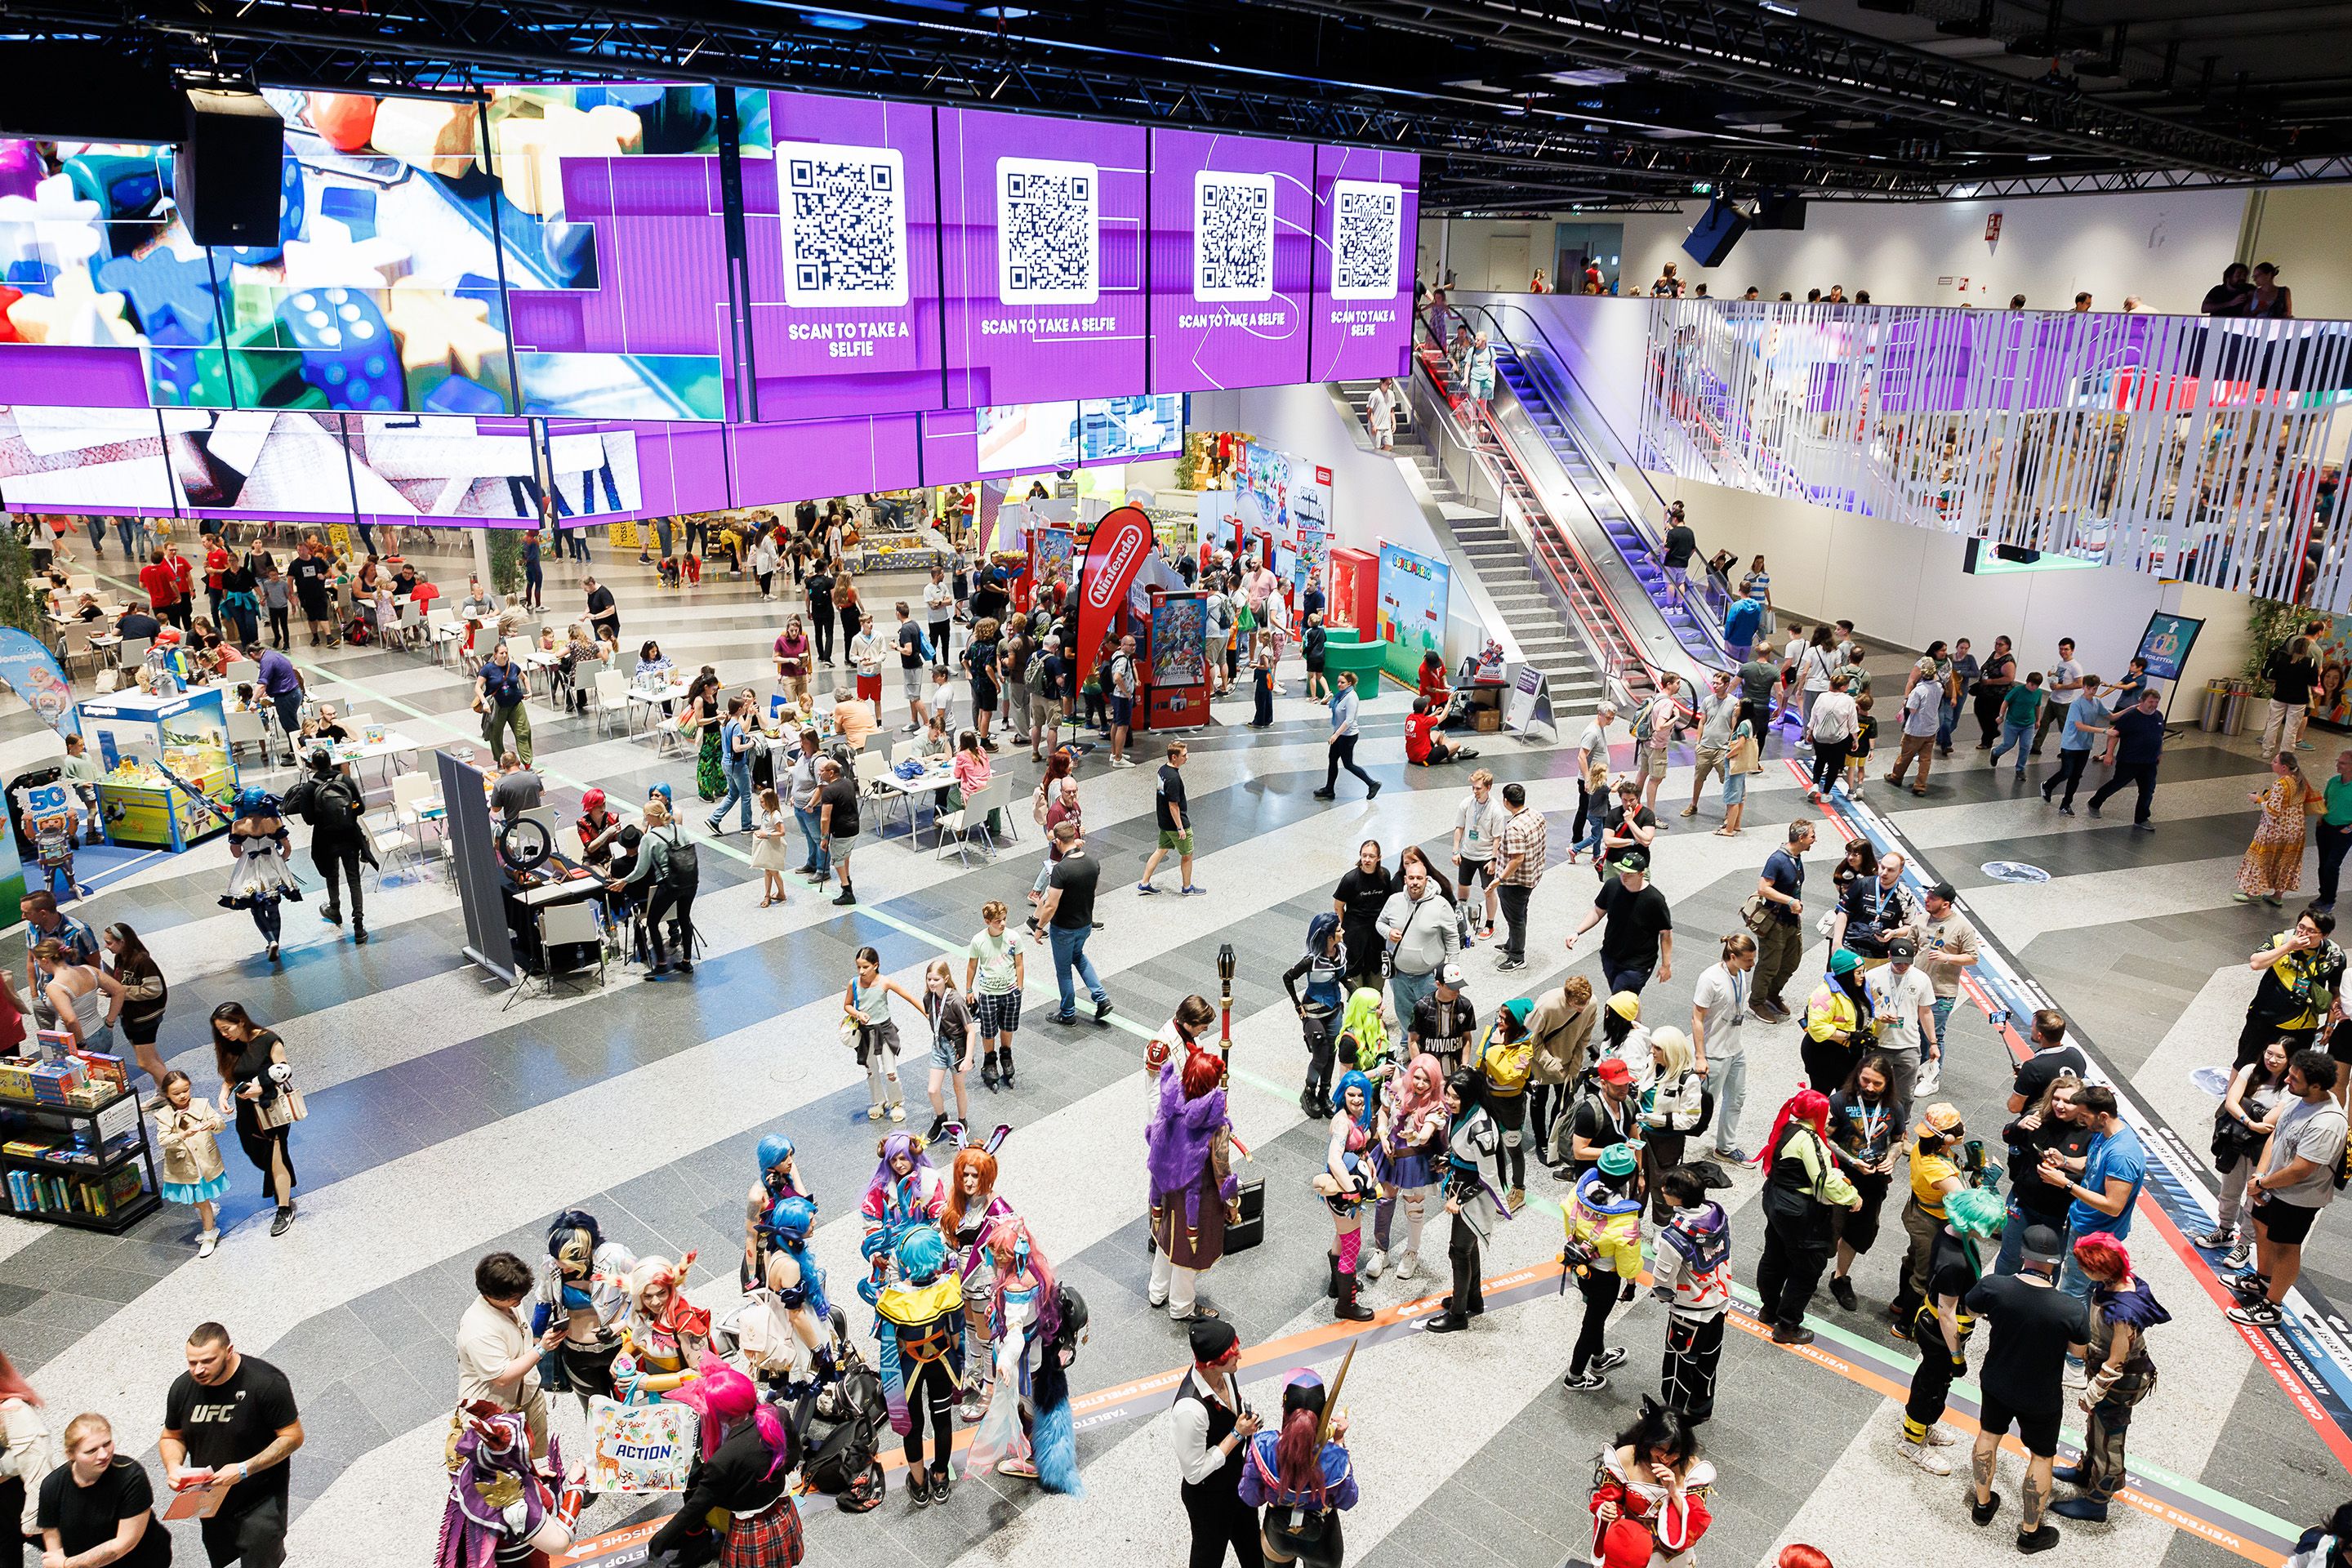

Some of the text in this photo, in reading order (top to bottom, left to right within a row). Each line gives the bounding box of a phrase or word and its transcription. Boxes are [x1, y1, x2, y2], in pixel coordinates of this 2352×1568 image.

[982, 317, 1116, 335] SCAN TO TAKE A SELFIE
[1178, 312, 1285, 328] SCAN TO TAKE A SELFIE
[1331, 310, 1396, 323] SCAN TO TAKE A
[788, 321, 909, 340] SCAN TO TAKE A
[1351, 323, 1376, 336] SELFIE
[829, 341, 874, 358] SELFIE
[1093, 533, 1136, 601] Nintendo
[1392, 553, 1432, 581] SUPER MARIO
[2145, 654, 2174, 665] TOILETTEN
[29, 786, 66, 812] 50
[33, 805, 69, 820] playmobil
[1490, 1272, 1535, 1289] WEITERE
[2292, 1328, 2323, 1359] GAMING
[1793, 1343, 1849, 1373] WEITERE
[2270, 1361, 2283, 1369] &
[2275, 1368, 2303, 1395] GAME
[189, 1404, 236, 1423] UFC
[2297, 1395, 2323, 1420] CARD
[615, 1444, 672, 1461] ACTION
[601, 1521, 668, 1548] ETISCHE
[2167, 1510, 2240, 1549] WEITERE
